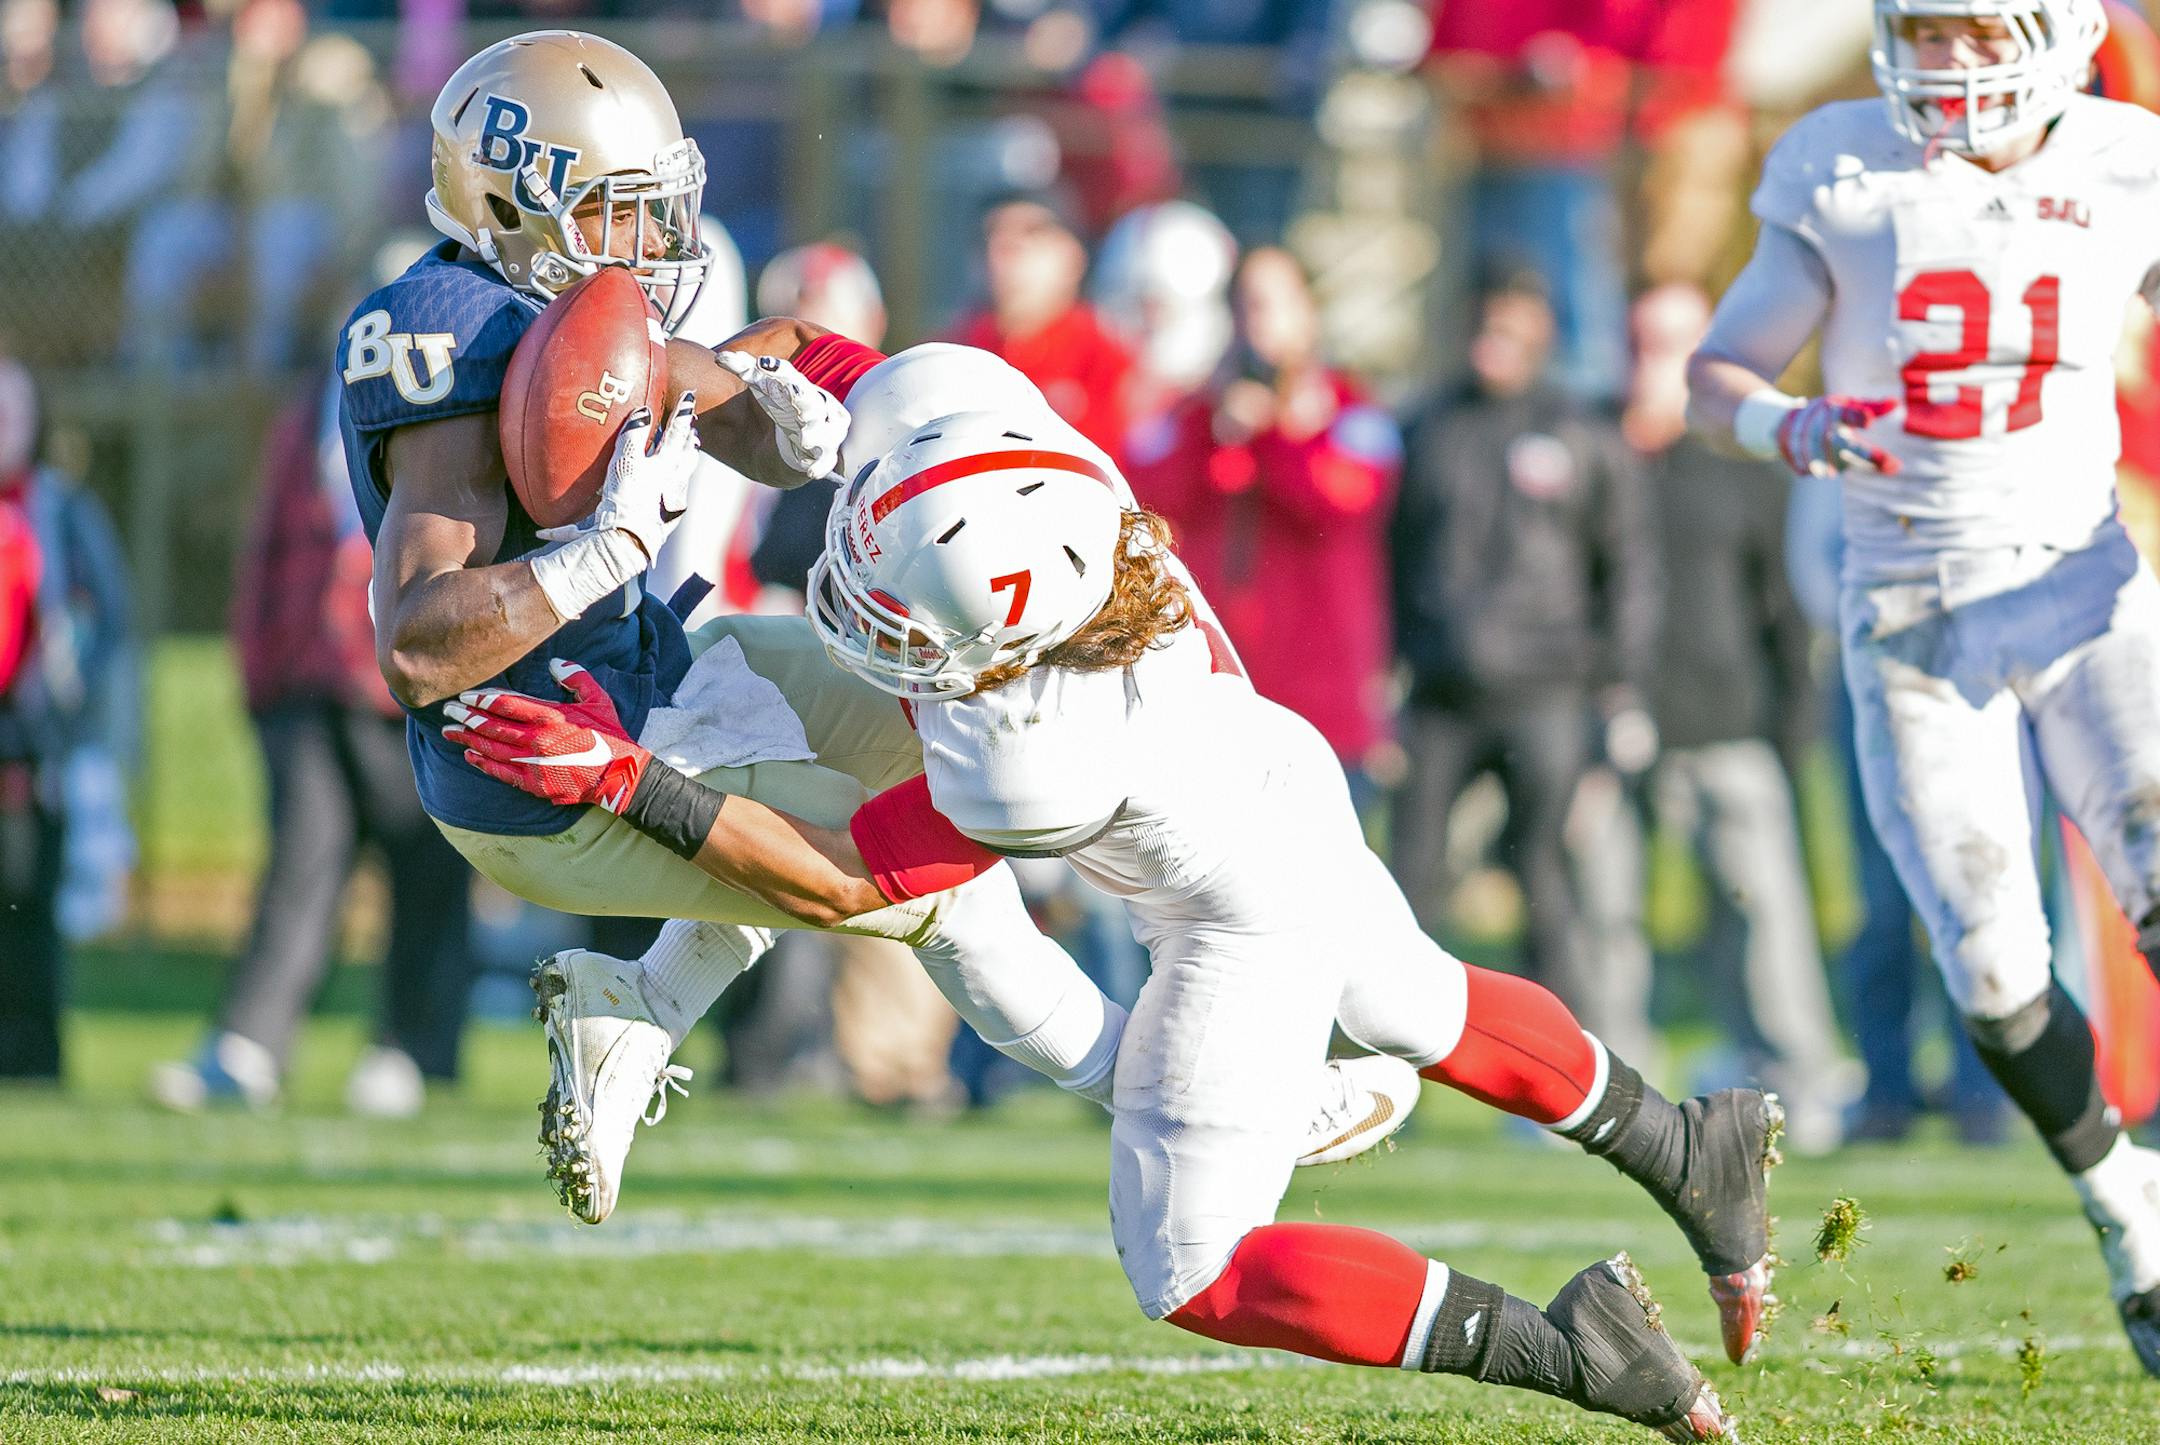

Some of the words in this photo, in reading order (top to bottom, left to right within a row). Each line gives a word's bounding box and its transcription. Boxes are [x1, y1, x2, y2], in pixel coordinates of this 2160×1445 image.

[471, 93, 582, 215] BU
[343, 309, 457, 404] BU
[1897, 270, 2060, 440] 21
[576, 369, 634, 426] BU
[858, 495, 882, 564] PEREZ
[990, 569, 1032, 628] 7
